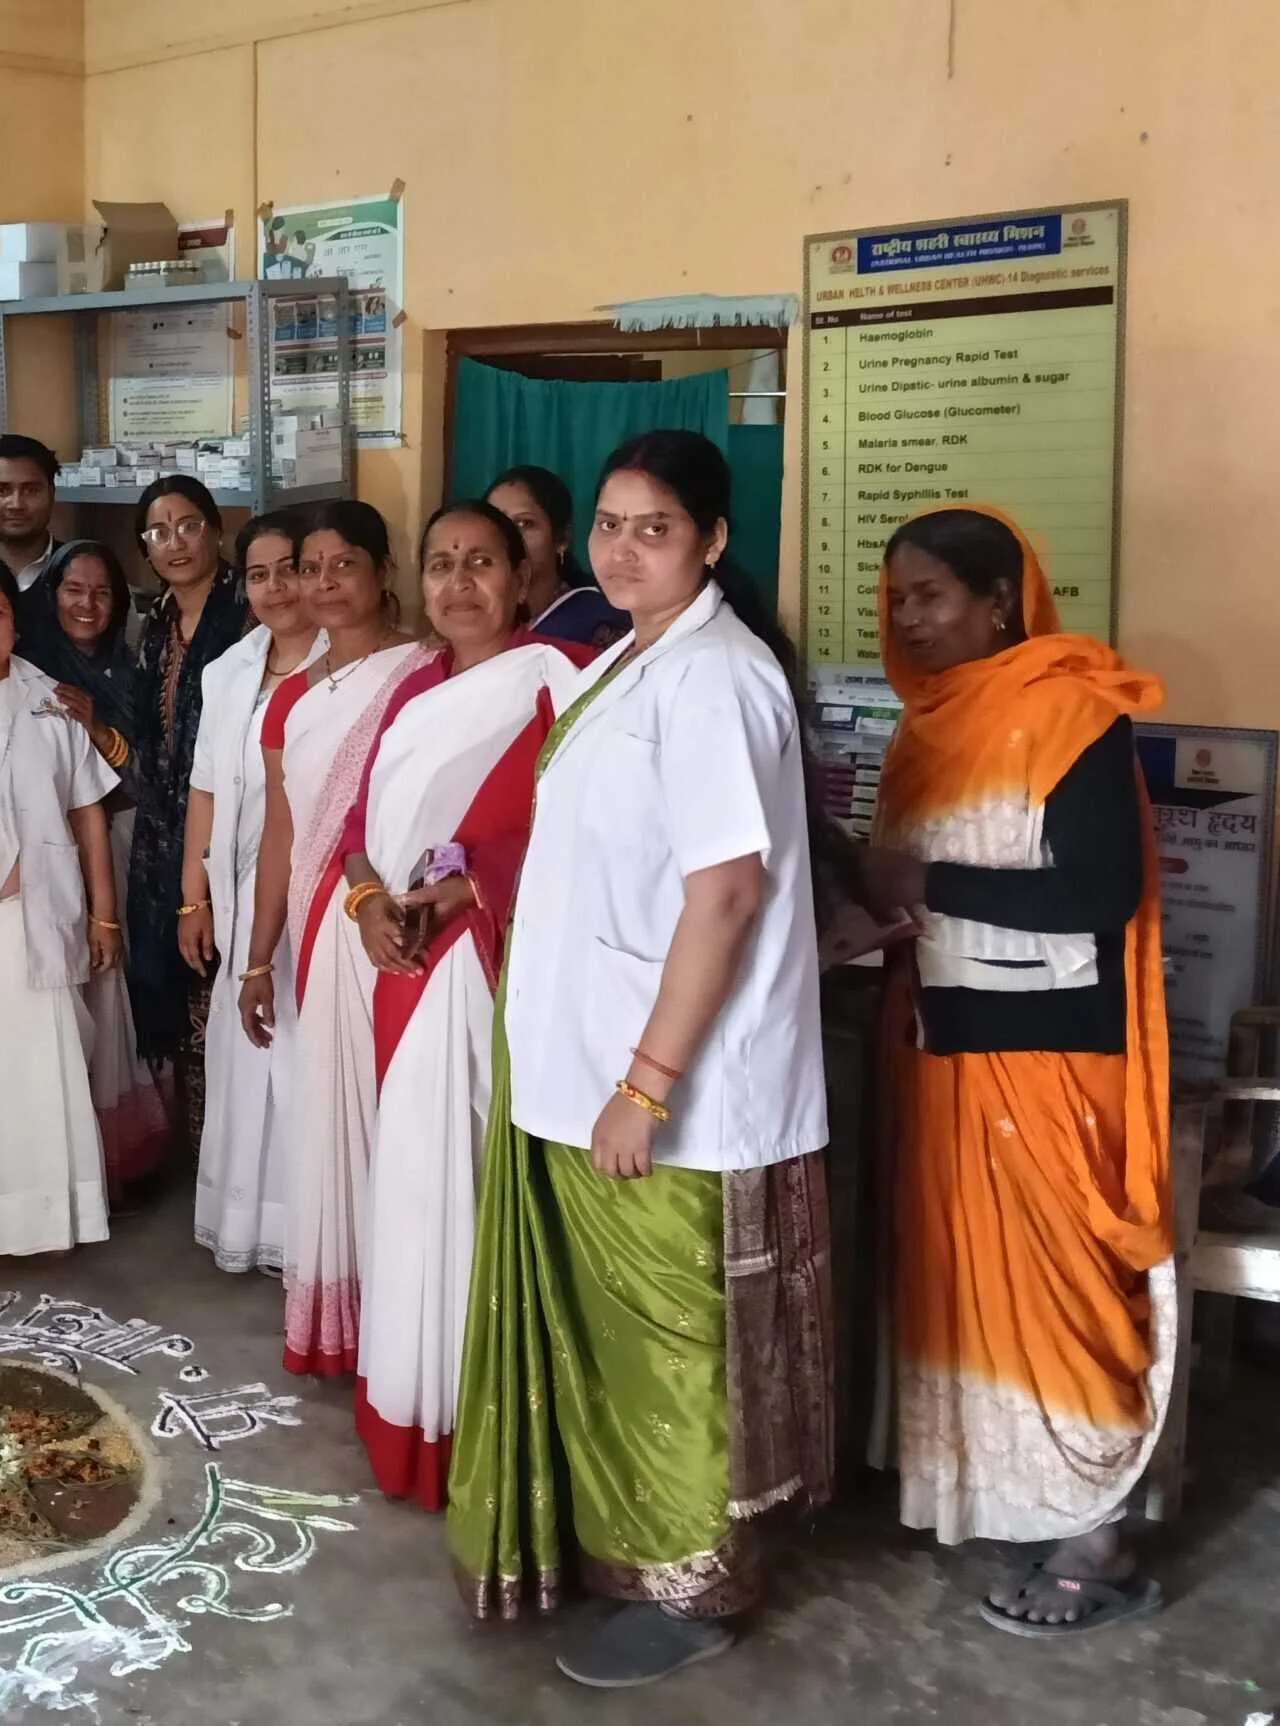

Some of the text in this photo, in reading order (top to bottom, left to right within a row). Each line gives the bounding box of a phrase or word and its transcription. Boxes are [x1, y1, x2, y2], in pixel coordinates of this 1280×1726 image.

[871, 236, 911, 257] राष्ट्रीय
[915, 232, 949, 252] शहरी
[953, 227, 999, 249] स्वास्थ्य
[1003, 223, 1045, 242] मिशन
[816, 288, 845, 301] URBAN
[849, 285, 876, 298] HELTH
[887, 281, 932, 296] WELLNESS
[934, 276, 970, 290] CENTER
[1021, 269, 1068, 284] Diagnostic
[1070, 265, 1110, 278] services
[860, 311, 884, 321] Name
[859, 328, 934, 343] Haemoglobin
[858, 359, 889, 370] Urine
[891, 355, 951, 369] Pregnancy
[955, 351, 990, 363] Rapid
[994, 349, 1018, 360] Test
[858, 383, 888, 394] Urine
[938, 377, 968, 389] urine
[971, 375, 1019, 387] albumin
[1022, 373, 1031, 384] &
[1035, 372, 1069, 384] sugar
[858, 410, 891, 422] Blood
[894, 408, 940, 420] Glucose
[943, 403, 1021, 419] (Glucometer)
[858, 437, 898, 449] Malaria
[942, 434, 968, 446] RDK
[858, 463, 883, 474] RDK
[885, 463, 902, 473] for
[904, 462, 949, 474] Dengue
[858, 489, 890, 502] Rapid
[944, 487, 969, 499] Test
[857, 514, 878, 525] HIV
[1053, 586, 1080, 597] AFB
